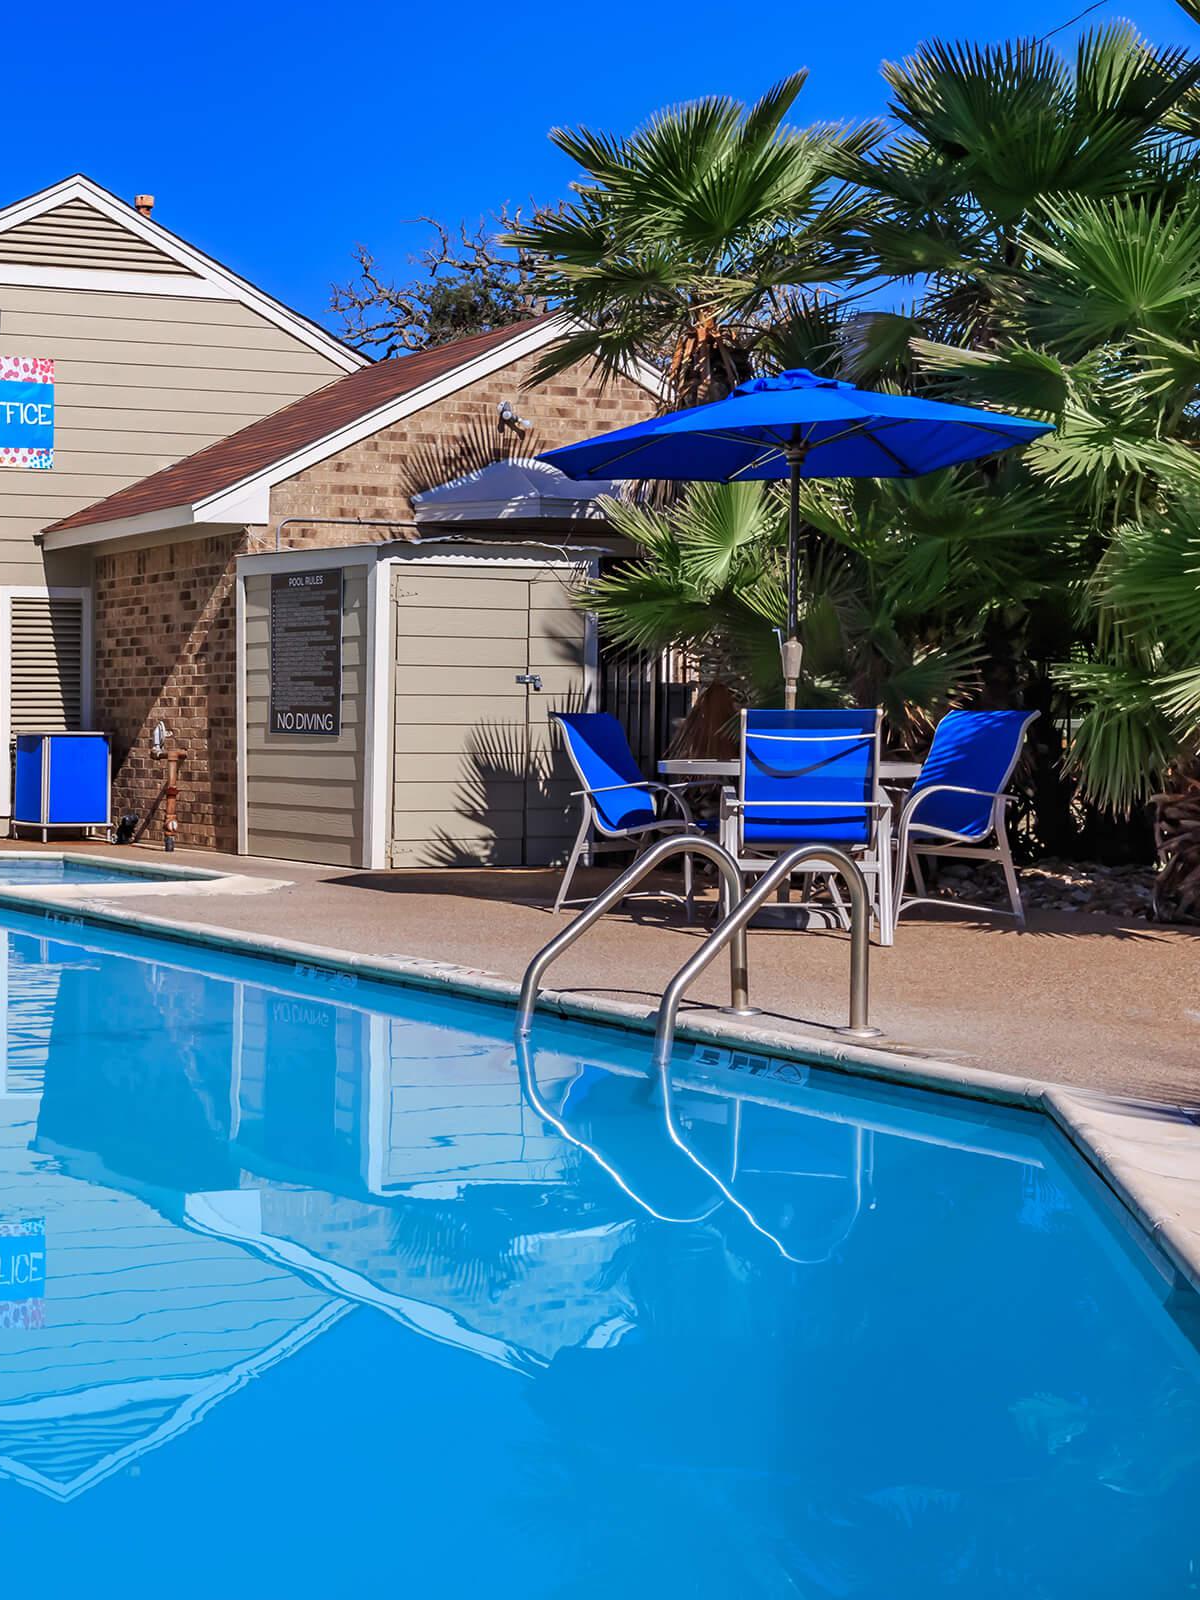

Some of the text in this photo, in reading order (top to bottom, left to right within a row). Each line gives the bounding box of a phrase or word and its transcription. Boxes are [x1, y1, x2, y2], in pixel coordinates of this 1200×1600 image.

[288, 575, 323, 587] POOL RULES
[277, 712, 333, 731] NO DIVING
